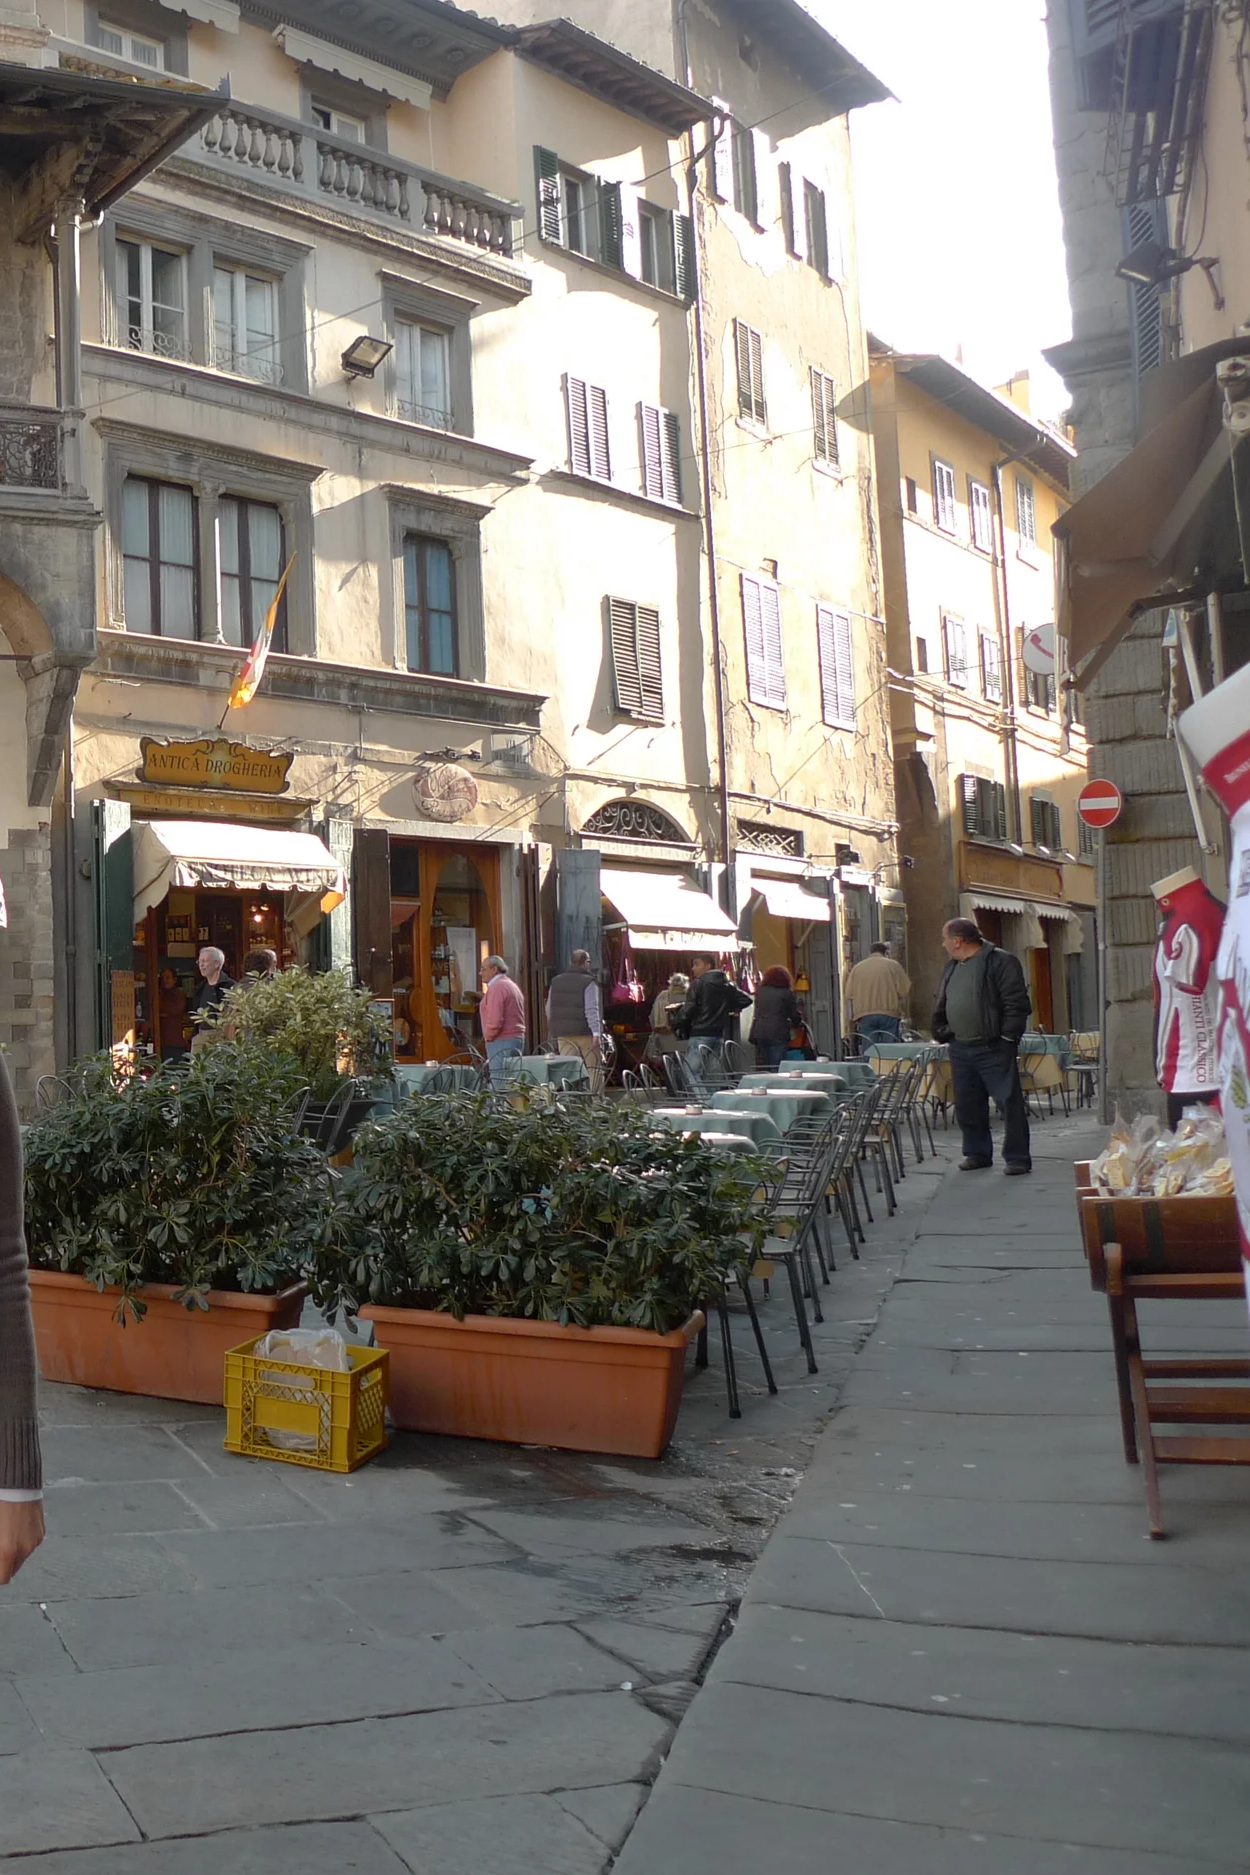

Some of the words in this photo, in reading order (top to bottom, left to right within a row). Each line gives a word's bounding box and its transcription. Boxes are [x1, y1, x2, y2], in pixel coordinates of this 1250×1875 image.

[147, 753, 200, 771] ANTICA
[205, 759, 283, 779] DROGHERIA
[143, 794, 216, 811] ENOTECA
[247, 802, 285, 816] WINE
[1192, 995, 1205, 1029] HIANTI
[1196, 1031, 1207, 1084] CLASSICO
